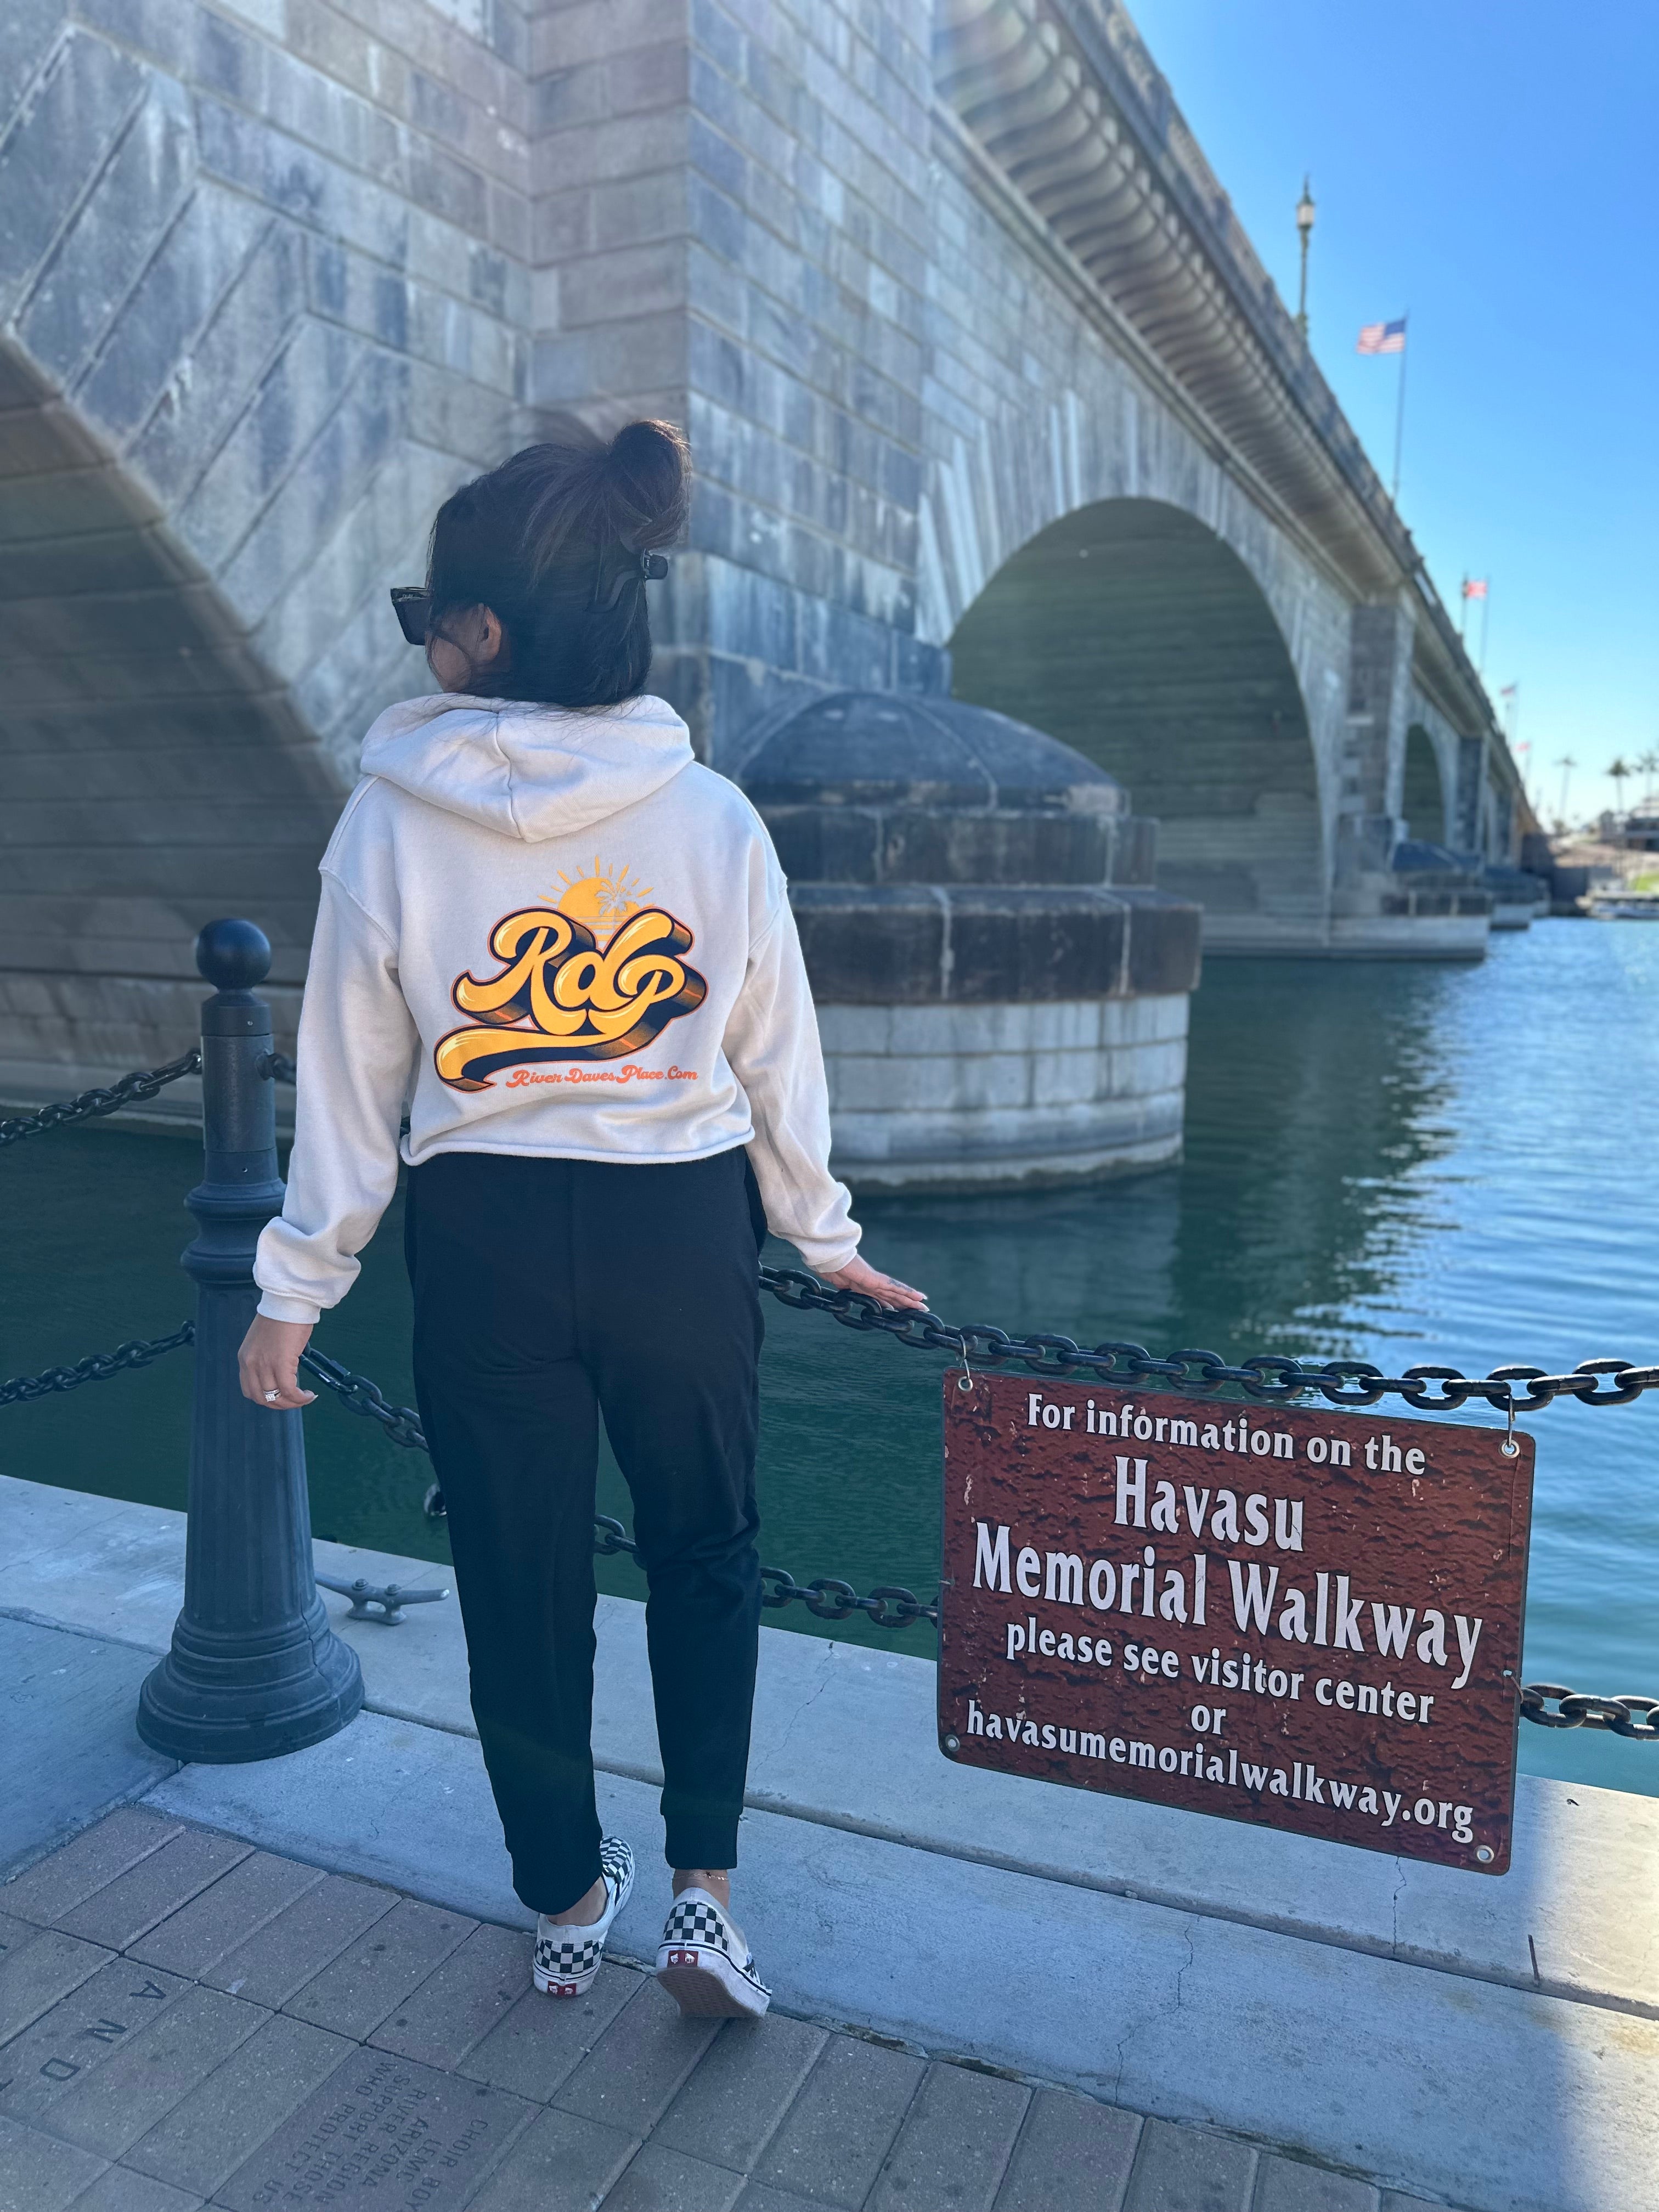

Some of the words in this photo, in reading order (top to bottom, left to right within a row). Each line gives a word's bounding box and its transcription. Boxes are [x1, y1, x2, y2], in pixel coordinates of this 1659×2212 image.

[1028, 1392, 1076, 1431] For
[1086, 1398, 1294, 1459] information
[1306, 1436, 1351, 1467] on
[1364, 1434, 1426, 1475] the
[1113, 1455, 1304, 1552] Havasu
[972, 1521, 1207, 1626] Memorial
[1227, 1559, 1483, 1690] Walkway
[1006, 1616, 1113, 1667] please
[1122, 1644, 1180, 1678] see
[1190, 1647, 1305, 1701] visitor
[1314, 1678, 1435, 1724] center
[1190, 1704, 1227, 1735] or
[966, 1699, 1474, 1844] havasumemorialwalkway.org
[40, 1980, 166, 2081] AND
[338, 2074, 412, 2143] SUPPORT
[353, 2059, 397, 2097] WHO
[376, 2088, 428, 2134] RIVER
[280, 2102, 357, 2173] PROTECT
[358, 2116, 432, 2189] ARIZONA
[437, 2117, 490, 2169] CHOIR
[250, 2179, 286, 2204] US
[280, 2147, 345, 2204] THOSE
[312, 2141, 381, 2205] REGION
[400, 2176, 442, 2212] BOY
